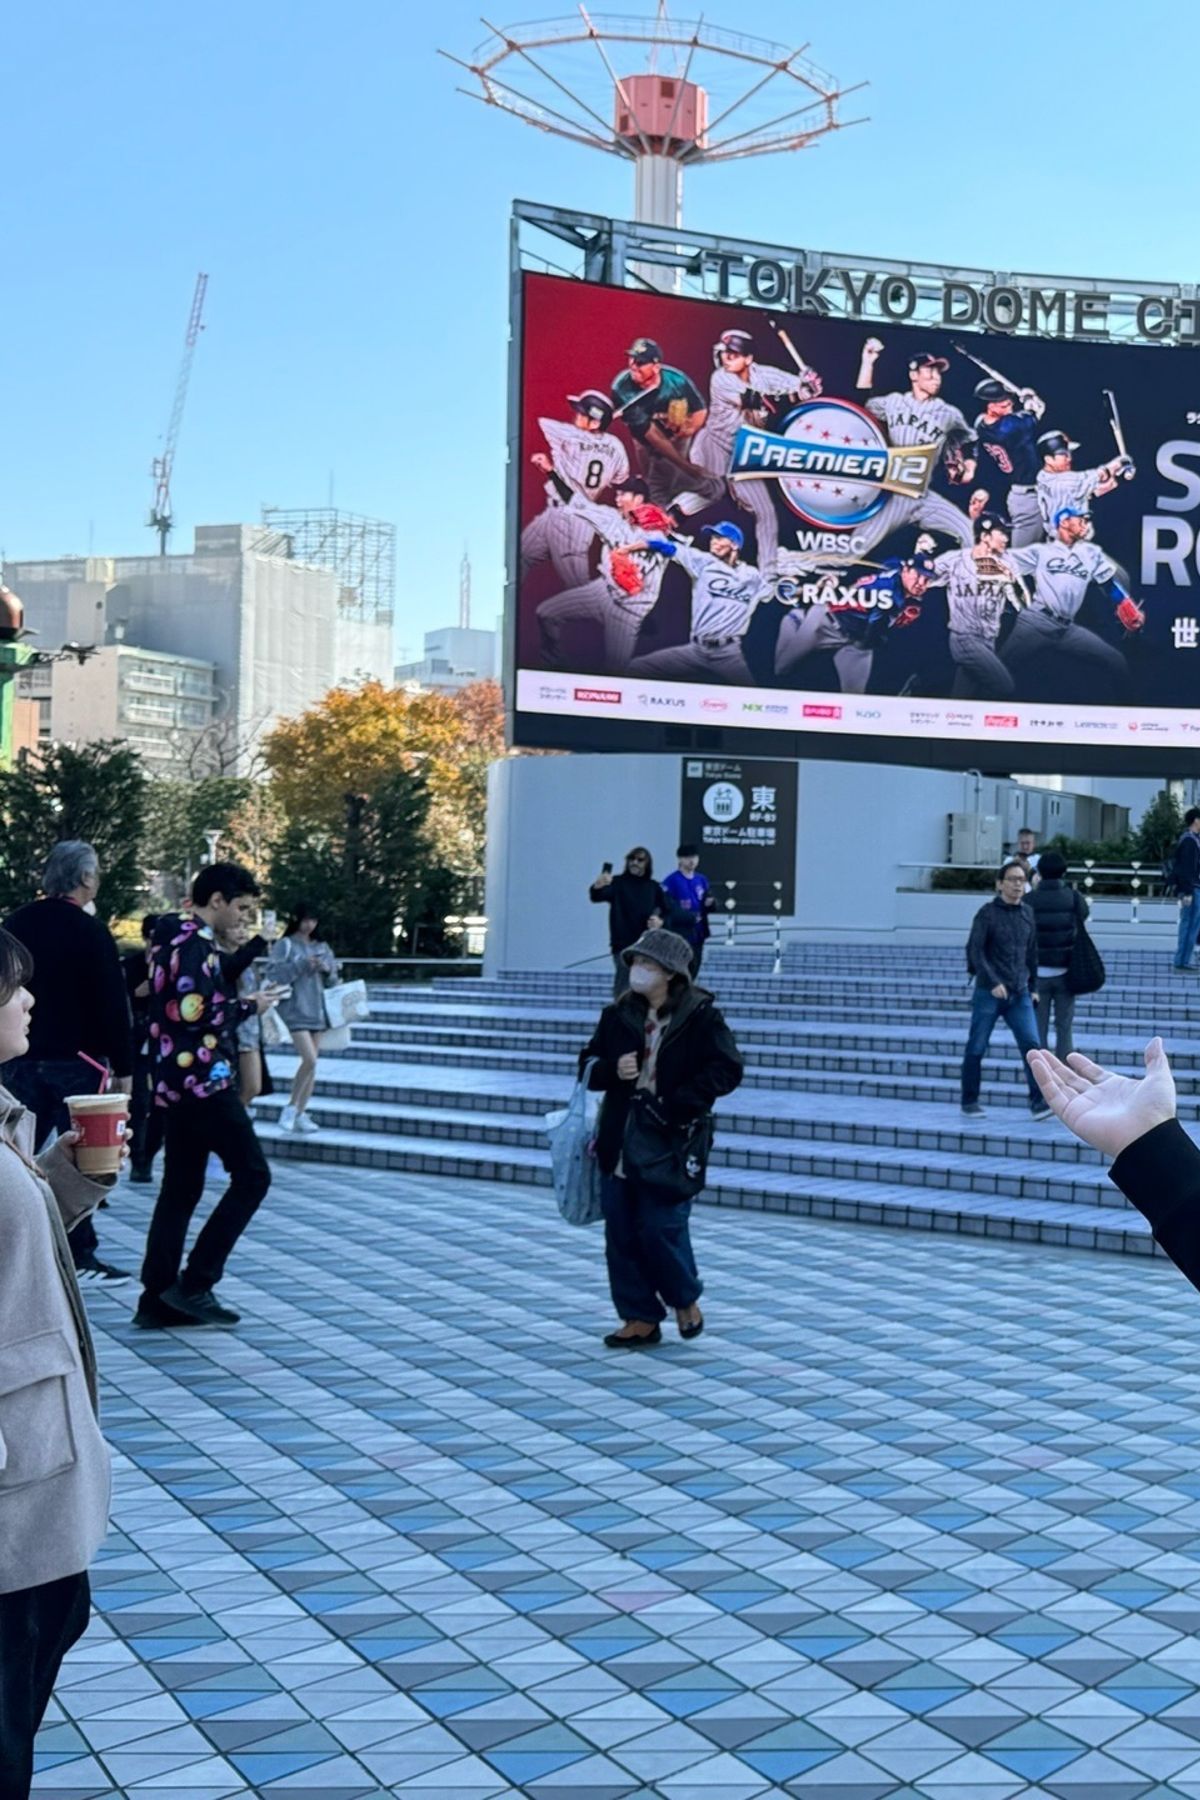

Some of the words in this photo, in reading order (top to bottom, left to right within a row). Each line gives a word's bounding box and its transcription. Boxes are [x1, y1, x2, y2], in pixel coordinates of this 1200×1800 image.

[703, 252, 917, 321] TOKYO
[943, 282, 1111, 338] DOME
[585, 460, 603, 488] 8
[739, 436, 886, 478] PREMIER
[890, 456, 928, 485] 12
[796, 531, 866, 554] WBSC
[803, 584, 893, 610] RAXUS
[751, 785, 776, 811] 東
